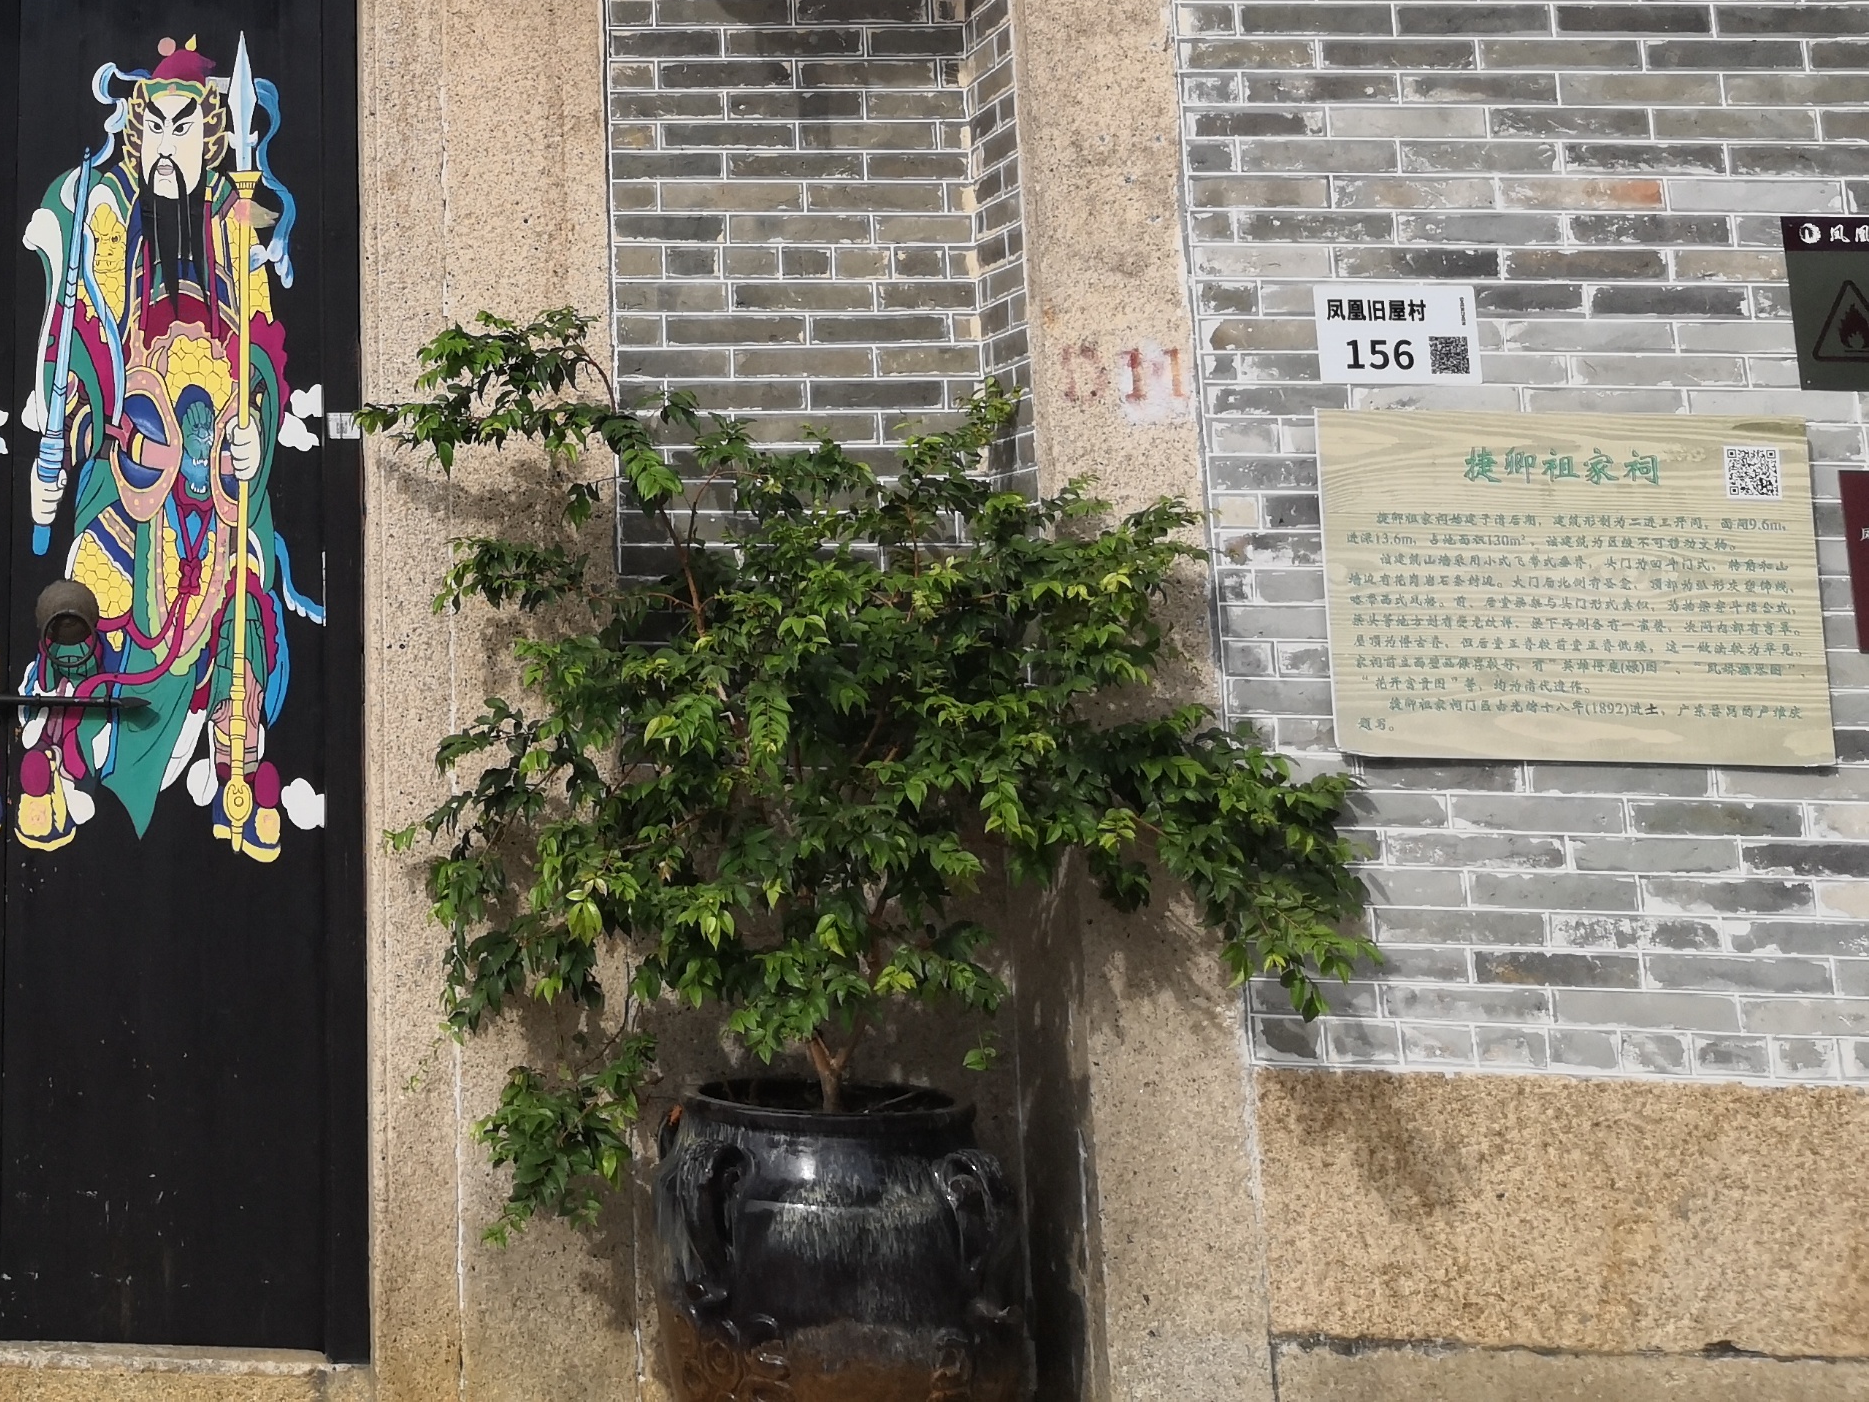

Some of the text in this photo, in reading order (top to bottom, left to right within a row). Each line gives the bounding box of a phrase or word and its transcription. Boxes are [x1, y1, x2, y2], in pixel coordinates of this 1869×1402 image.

[1327, 299, 1427, 322] 凤凰旧屋村
[1346, 339, 1414, 370] 156
[1463, 447, 1660, 485] 捷卿祖家祠
